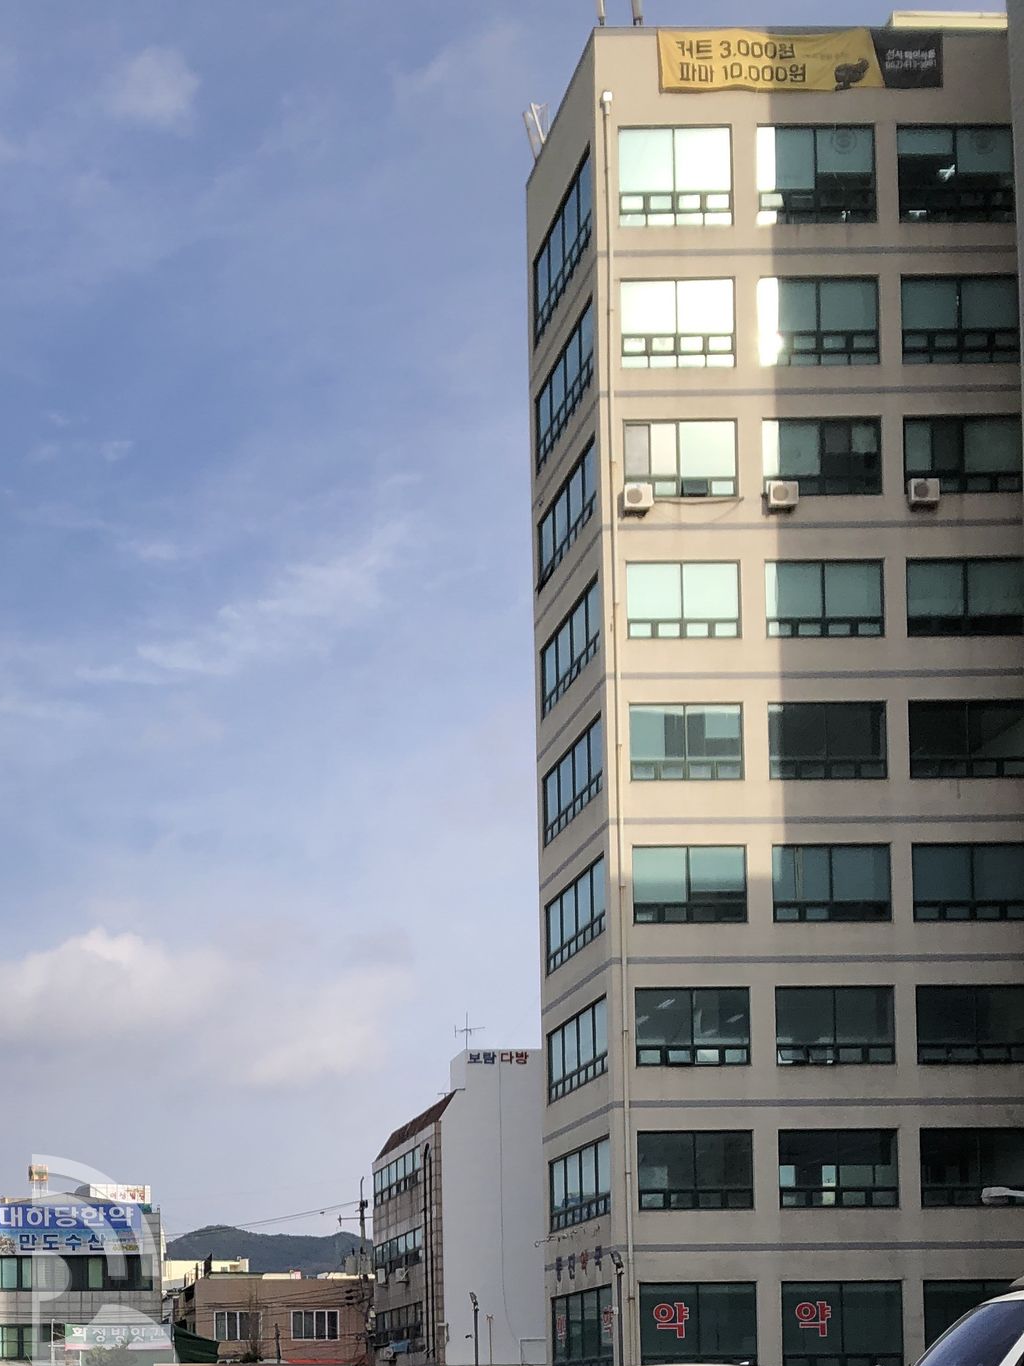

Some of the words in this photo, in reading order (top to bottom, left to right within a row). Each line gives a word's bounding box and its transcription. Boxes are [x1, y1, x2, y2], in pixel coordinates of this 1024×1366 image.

[676, 40, 713, 60] 커트
[679, 62, 714, 83] 파마
[653, 1302, 689, 1339] 약
[795, 1301, 831, 1338] 약
